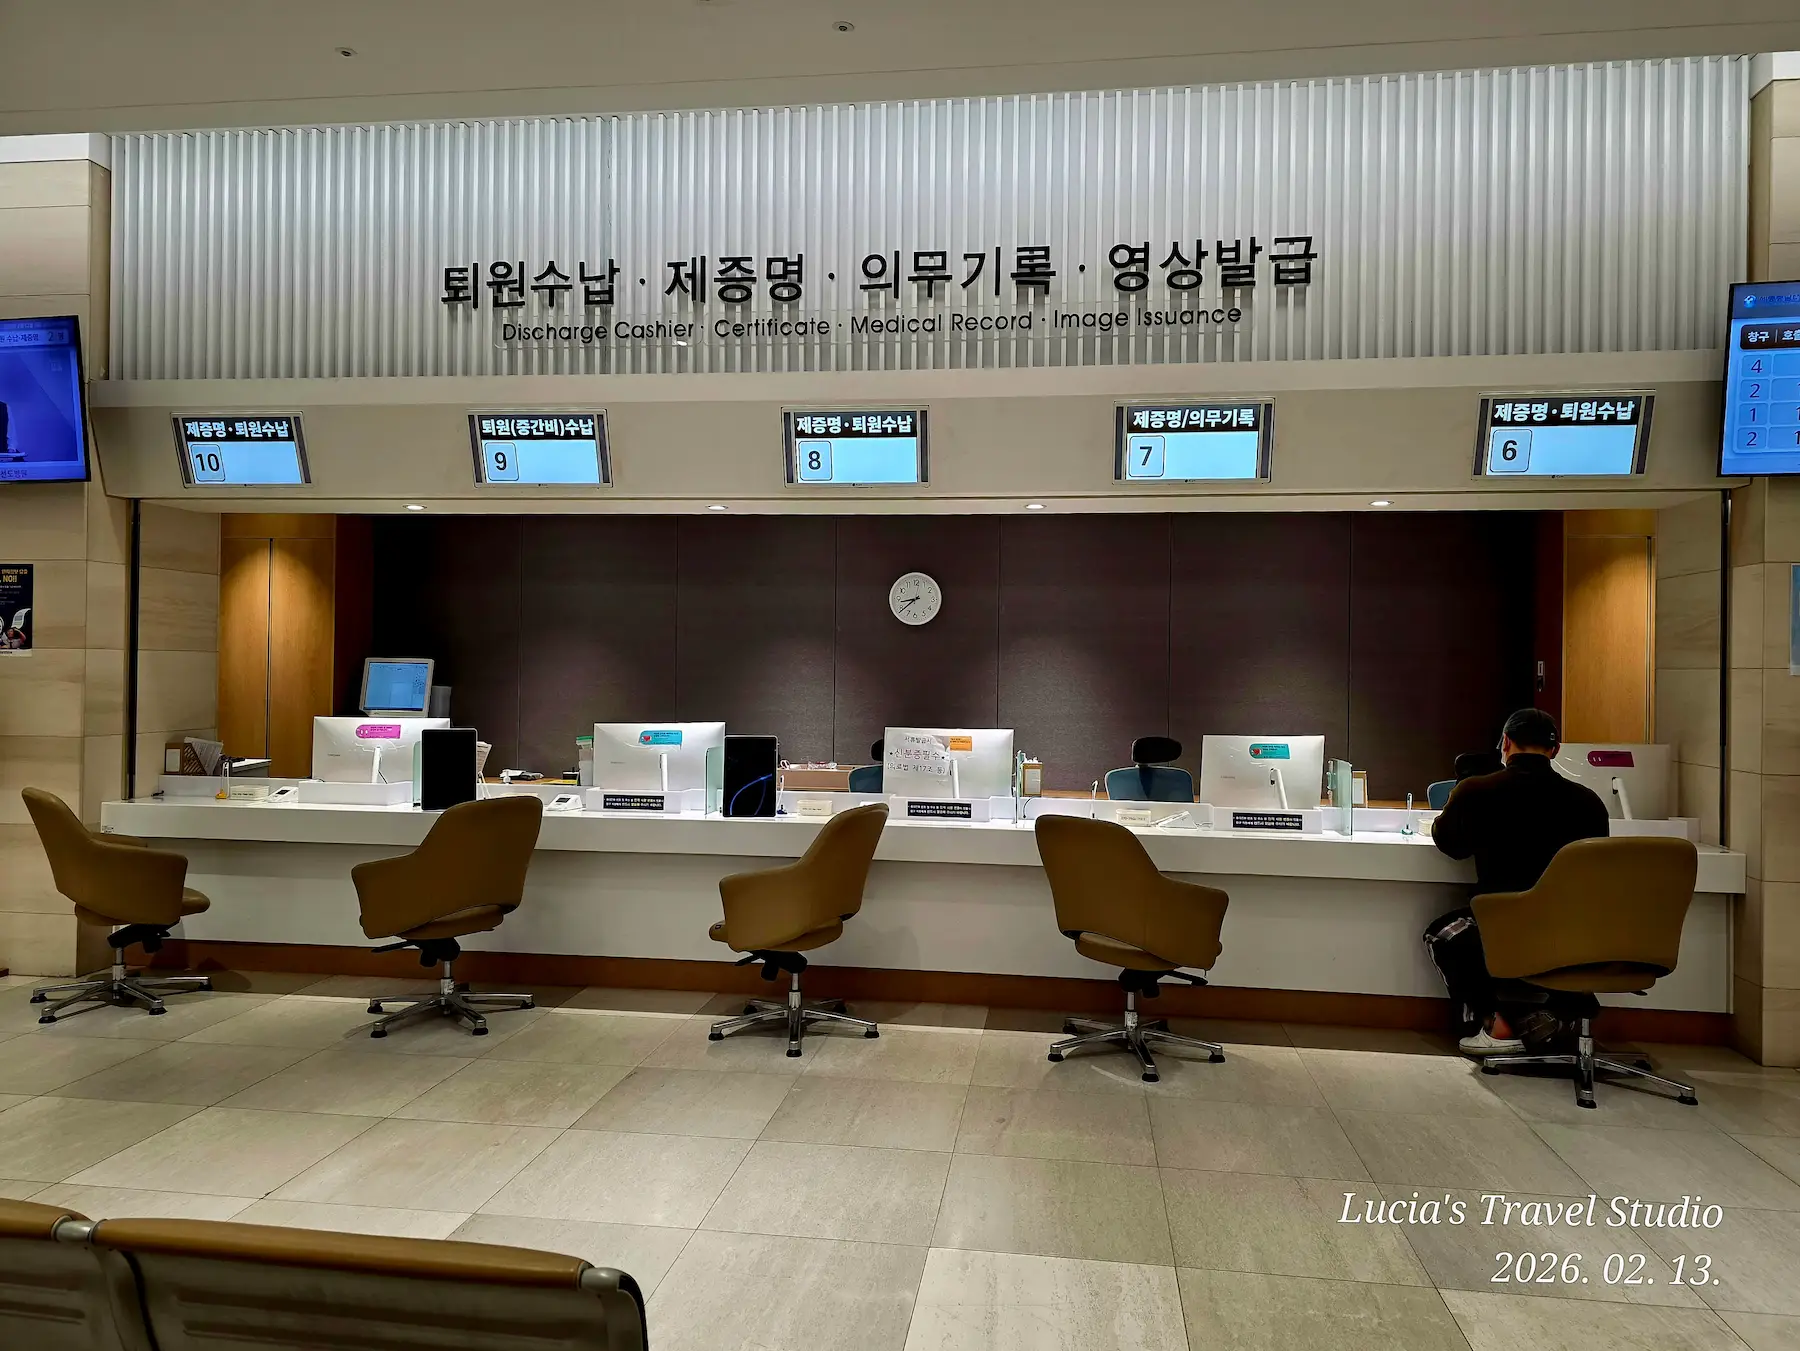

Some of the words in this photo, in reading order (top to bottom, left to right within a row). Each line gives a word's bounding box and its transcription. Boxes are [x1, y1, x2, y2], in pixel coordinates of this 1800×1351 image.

[441, 258, 620, 310] 퇴원수납
[665, 253, 804, 304] 제증명
[859, 246, 1056, 299] 의무기록
[1108, 235, 1318, 292] 영상발급
[502, 322, 608, 345] Discharge
[614, 320, 695, 340] Cashier
[714, 317, 831, 339] Certificate
[851, 313, 943, 335] Medical
[951, 311, 1033, 332] Record
[1053, 309, 1129, 332] Image
[1137, 307, 1243, 327] Issuance
[1747, 331, 1770, 343] 창구
[1751, 359, 1763, 374] 4
[1749, 384, 1761, 398] 2
[1132, 408, 1255, 430] 제증명/의무기록
[1750, 408, 1756, 422] 1
[481, 418, 594, 437] 퇴원(중간비)수납
[1746, 432, 1757, 446] 2
[1139, 446, 1154, 467] 7
[1502, 440, 1518, 461] 6
[195, 451, 221, 474] 10
[494, 452, 508, 472] 9
[807, 451, 822, 470] 8
